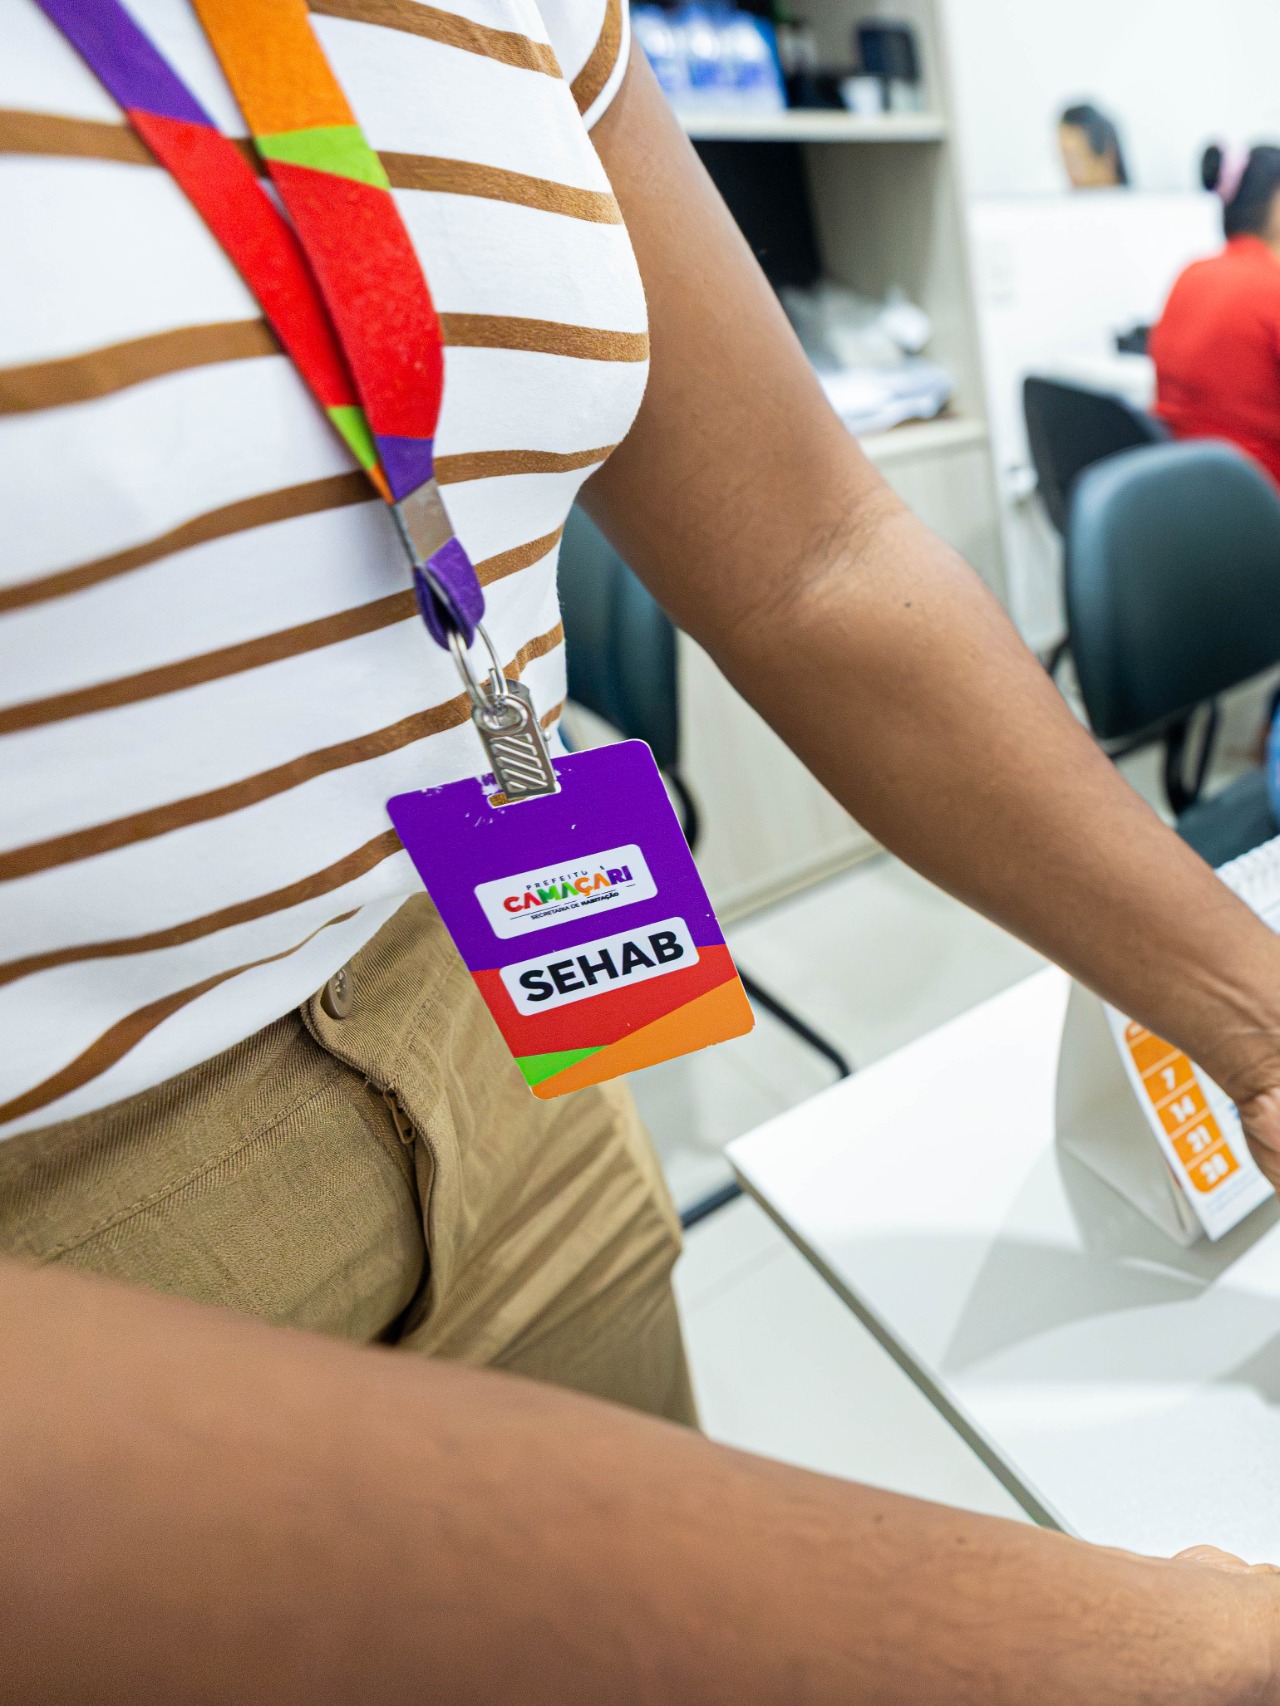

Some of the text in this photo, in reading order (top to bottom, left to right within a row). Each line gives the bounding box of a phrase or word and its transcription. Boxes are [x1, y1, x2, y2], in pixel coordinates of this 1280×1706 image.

[503, 865, 633, 912] CAMAÇARI
[531, 906, 569, 920] SECRETARIA
[519, 931, 684, 1002] SEHAB
[1161, 1067, 1176, 1090] 7
[1169, 1096, 1196, 1123] 14
[1187, 1125, 1212, 1153] 21
[1201, 1153, 1229, 1185] 28
